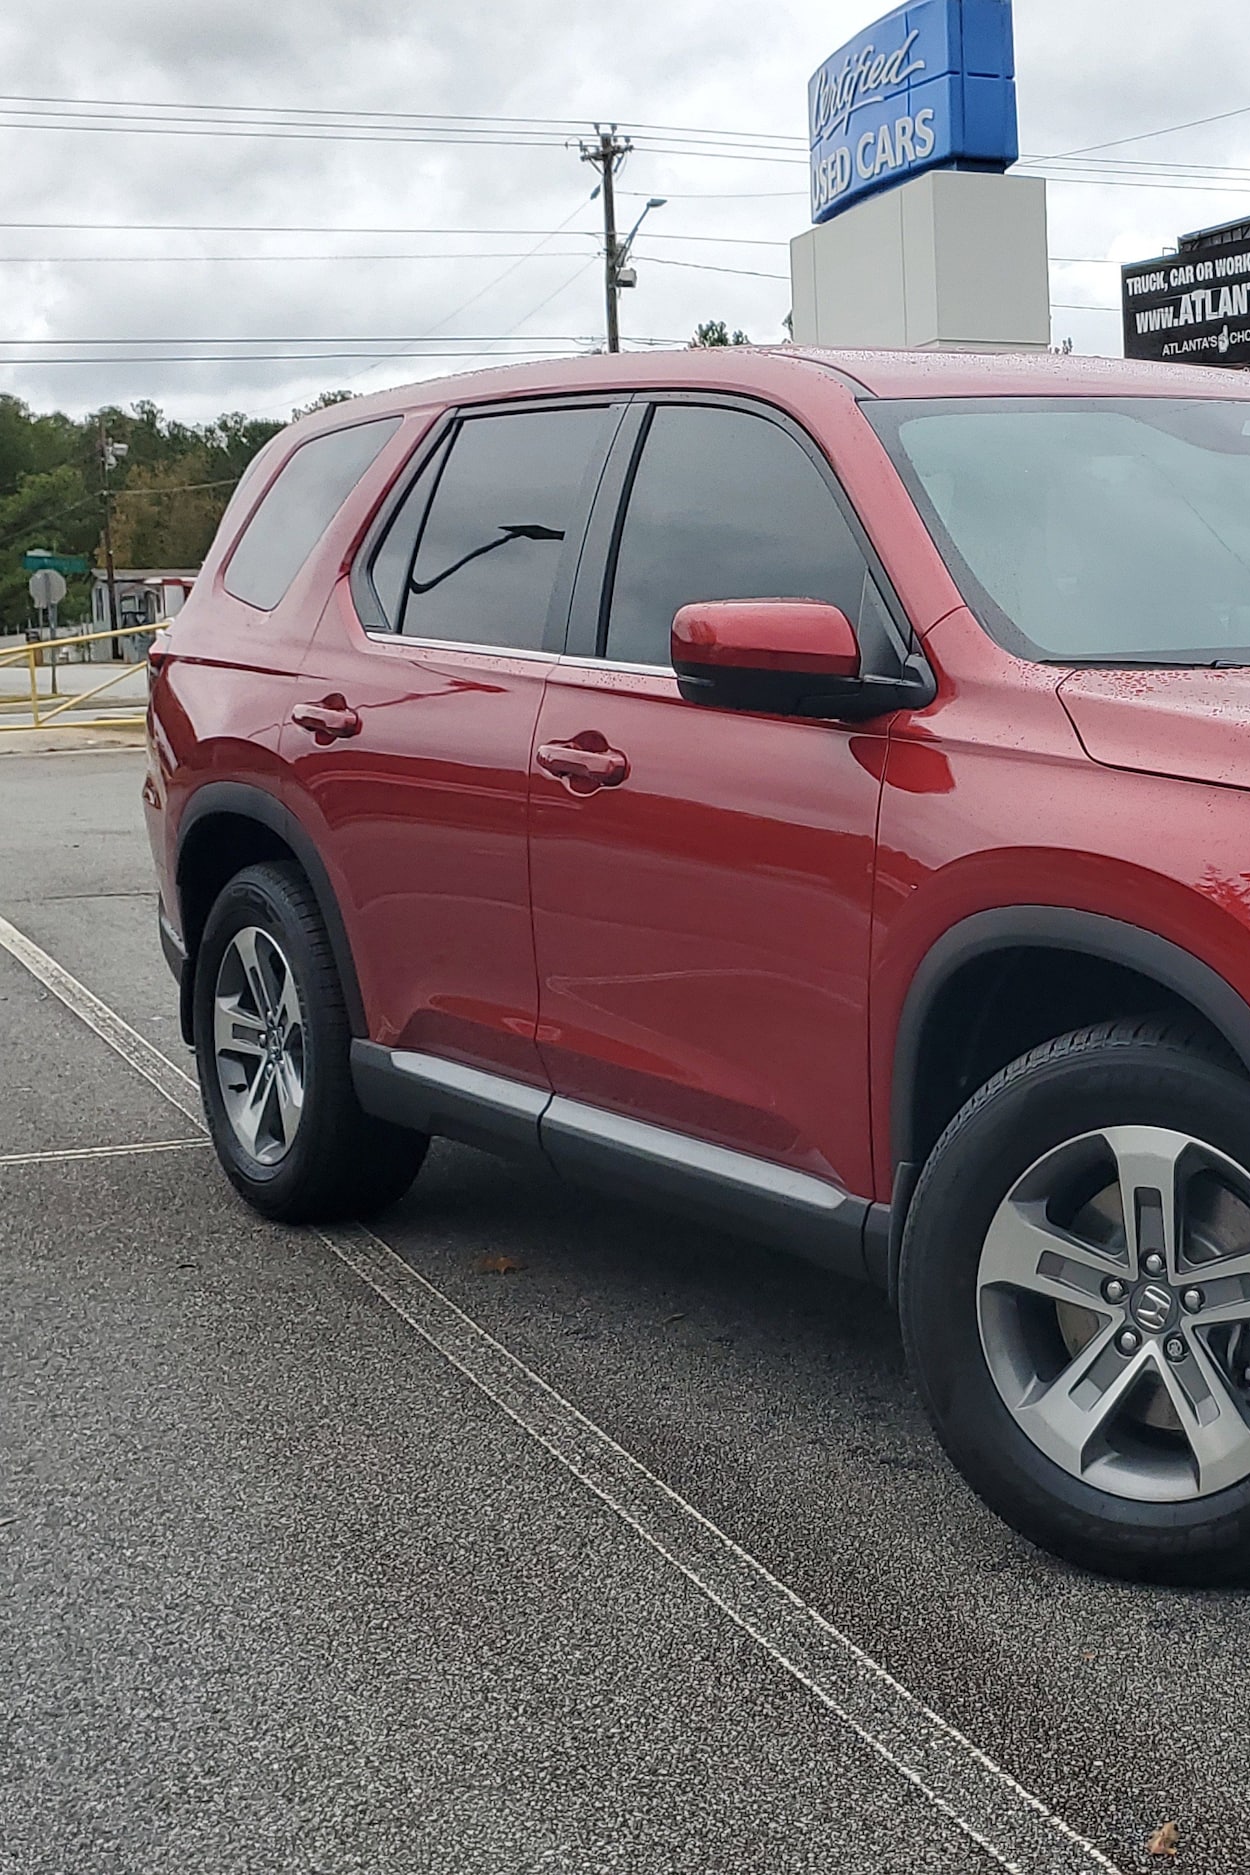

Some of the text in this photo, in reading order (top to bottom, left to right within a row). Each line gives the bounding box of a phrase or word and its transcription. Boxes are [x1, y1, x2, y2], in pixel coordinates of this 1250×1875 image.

[812, 29, 926, 137] Certified
[811, 108, 935, 211] USED CARS
[1126, 270, 1168, 297] TRUCK,
[1169, 265, 1195, 288] CAR
[1196, 260, 1214, 282] OR
[1161, 335, 1219, 357] ATLANTA'S
